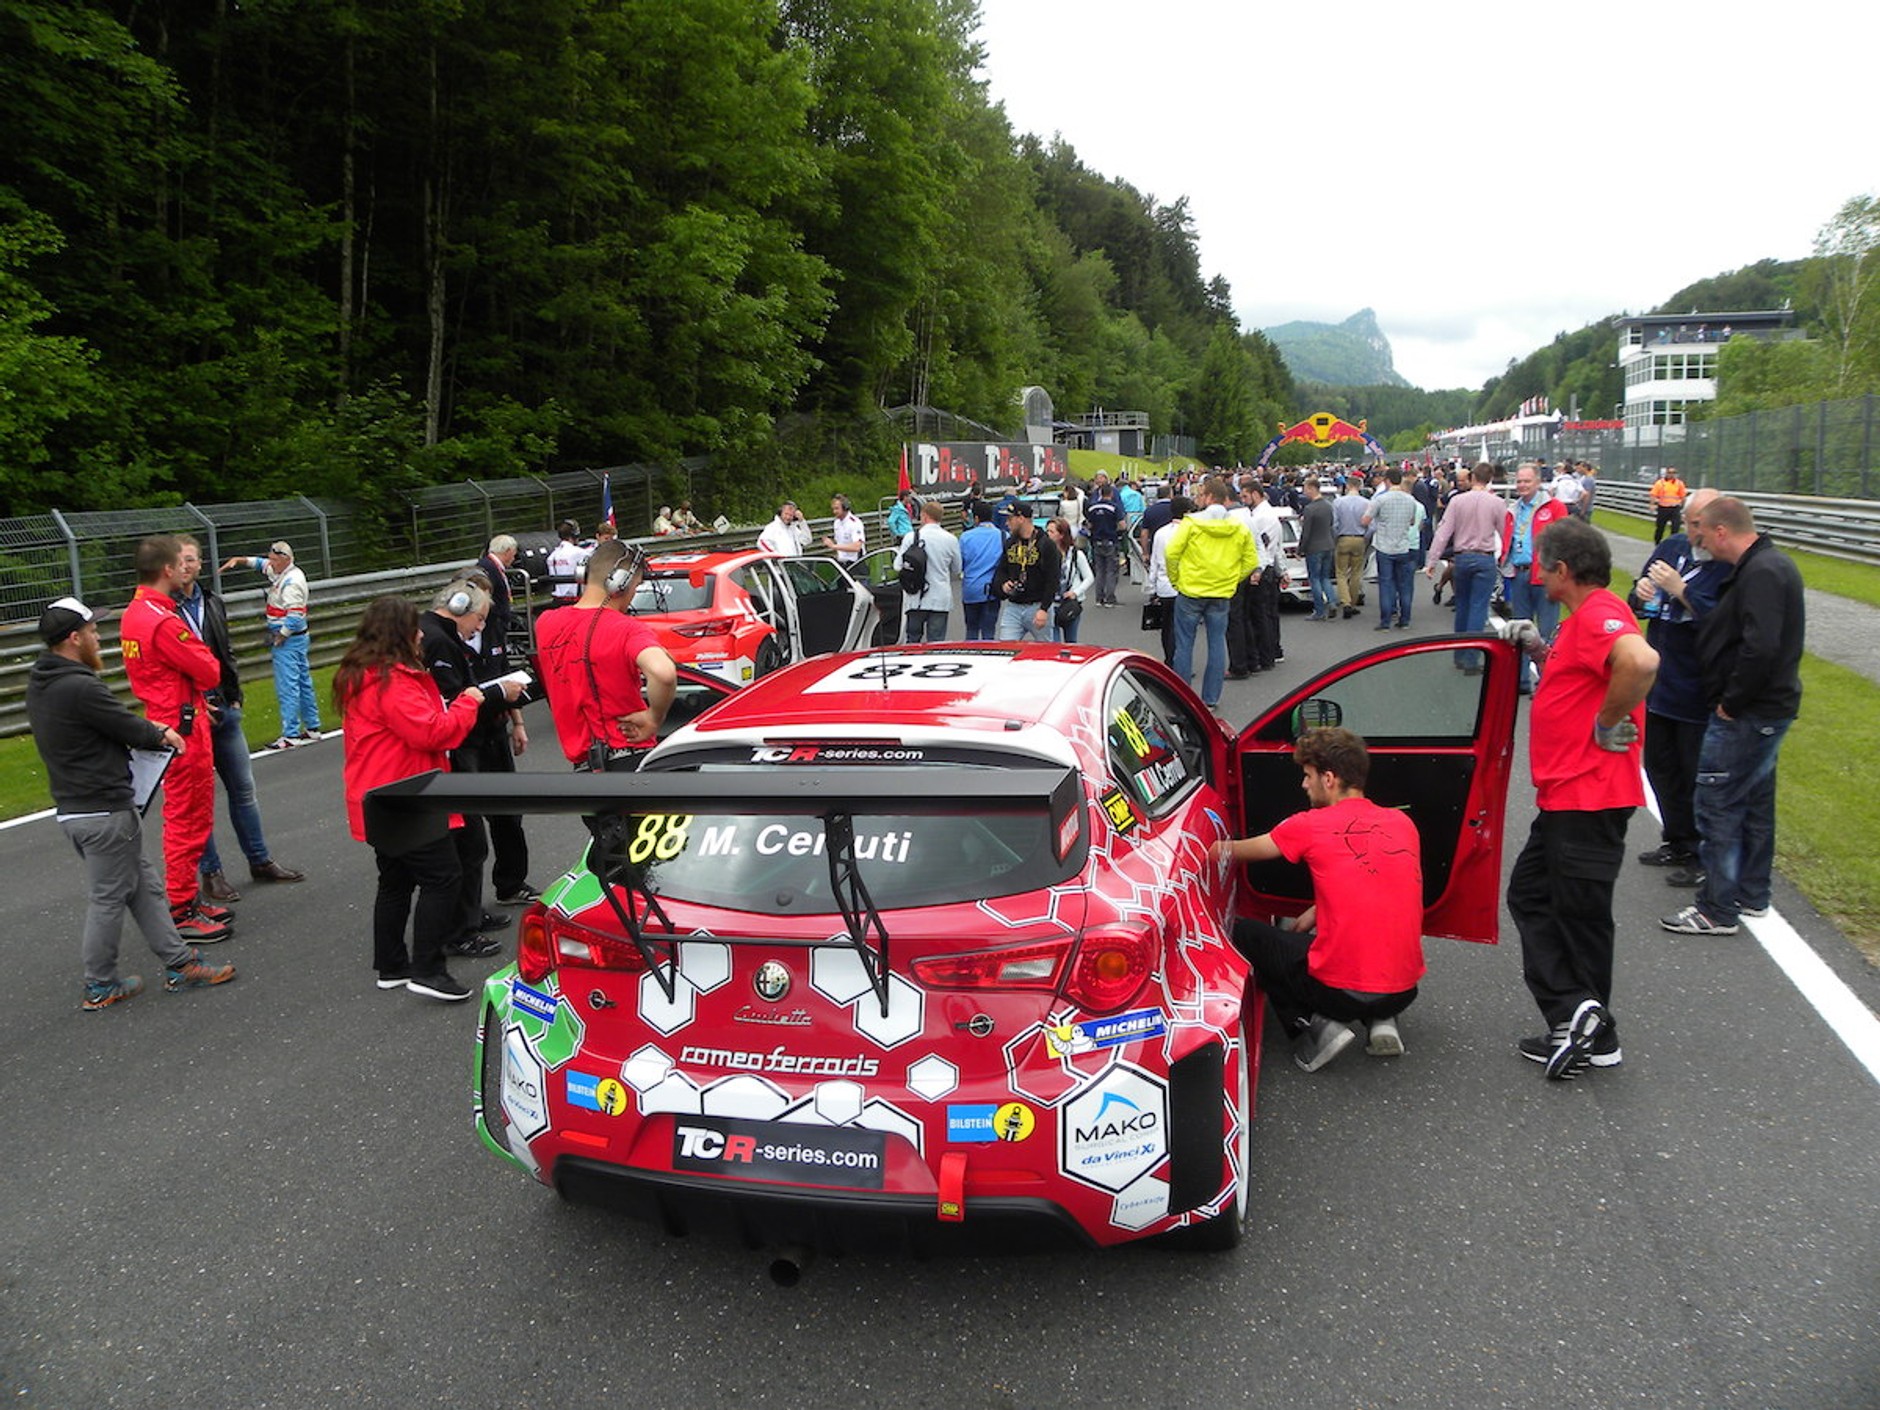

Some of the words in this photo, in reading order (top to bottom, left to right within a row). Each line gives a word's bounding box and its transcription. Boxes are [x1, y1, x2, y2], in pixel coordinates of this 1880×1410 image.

[848, 662, 973, 679] 88
[1113, 706, 1150, 757] 88
[750, 747, 924, 762] TCR-series.com
[629, 814, 693, 863] 88
[698, 825, 741, 856] M.
[755, 824, 912, 863] Ceruti
[516, 988, 556, 1015] MICHELIN
[1096, 1013, 1162, 1037] MICHELIN
[949, 1117, 992, 1129] BILSTEIN
[1075, 1112, 1156, 1143] MAKO
[676, 1126, 878, 1169] TCR-series.com
